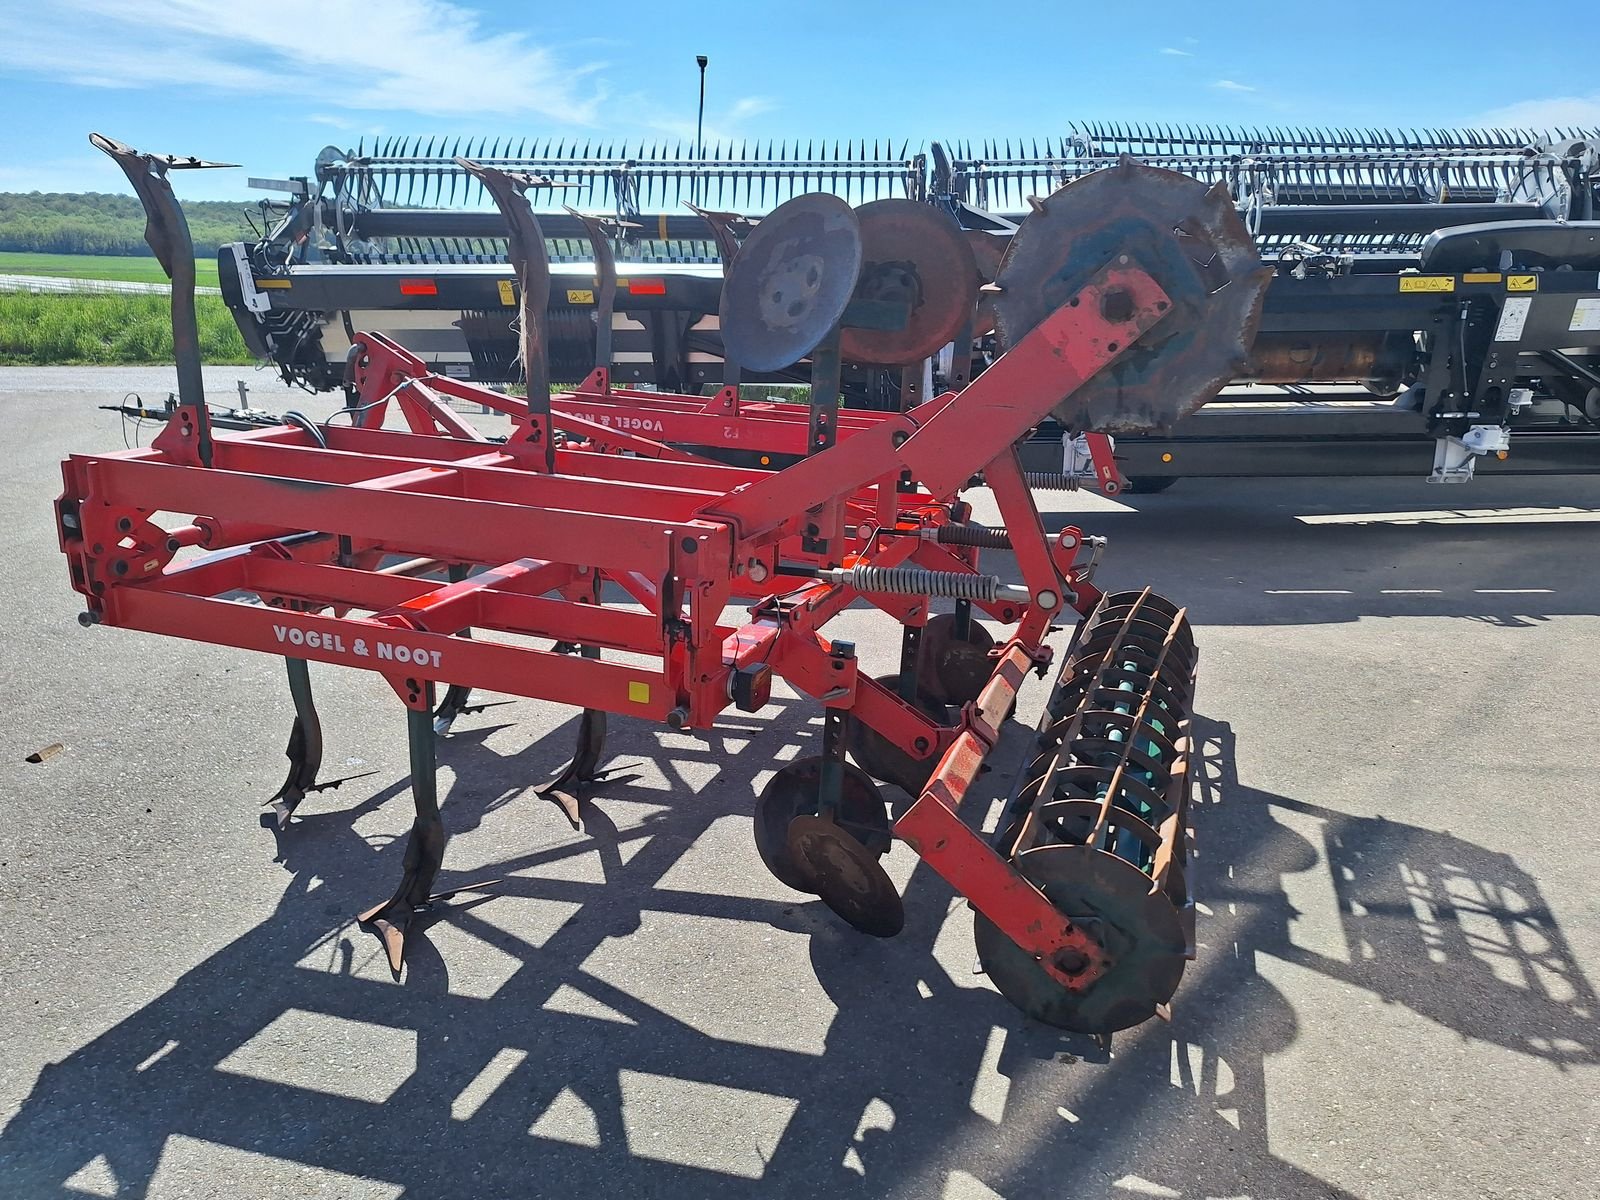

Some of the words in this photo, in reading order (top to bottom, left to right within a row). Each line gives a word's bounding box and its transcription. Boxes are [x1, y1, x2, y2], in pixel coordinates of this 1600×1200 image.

[600, 414, 610, 426] &
[616, 416, 663, 432] VOGEL
[273, 624, 346, 653] VOGEL
[352, 638, 370, 657] &
[377, 641, 442, 668] NOOT
